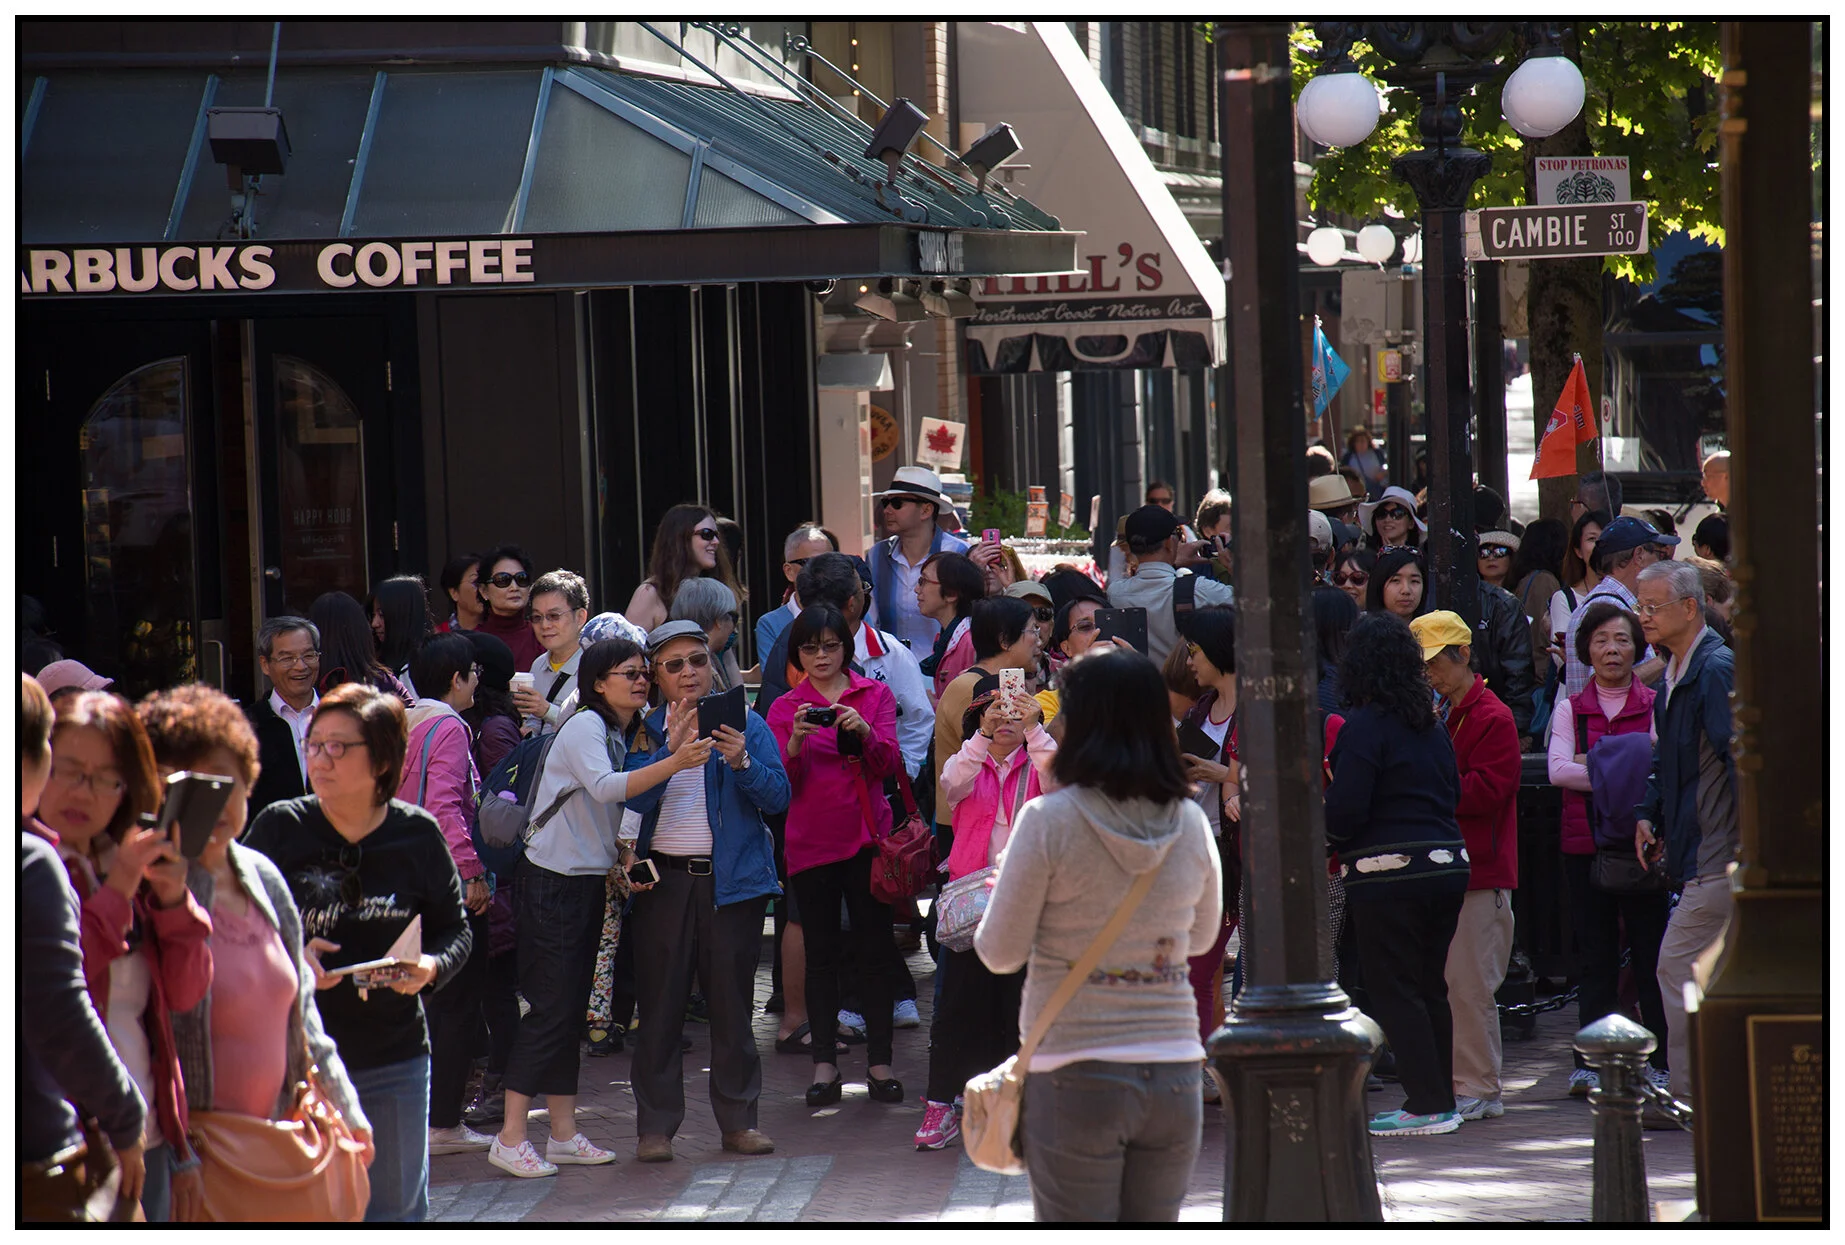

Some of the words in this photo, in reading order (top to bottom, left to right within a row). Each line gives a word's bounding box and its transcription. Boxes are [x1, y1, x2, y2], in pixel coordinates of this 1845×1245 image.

[1539, 161, 1568, 171] STOP
[1570, 159, 1628, 171] PETRONAS
[1492, 214, 1588, 249] CAMBIE
[1611, 213, 1626, 230] ST
[1608, 230, 1634, 246] 100
[317, 240, 534, 288] COFFEE
[1054, 302, 1103, 319] Coast
[1106, 302, 1162, 318] Native
[1166, 297, 1204, 316] Art
[293, 508, 323, 526] HAPPY
[327, 507, 352, 524] HOUR
